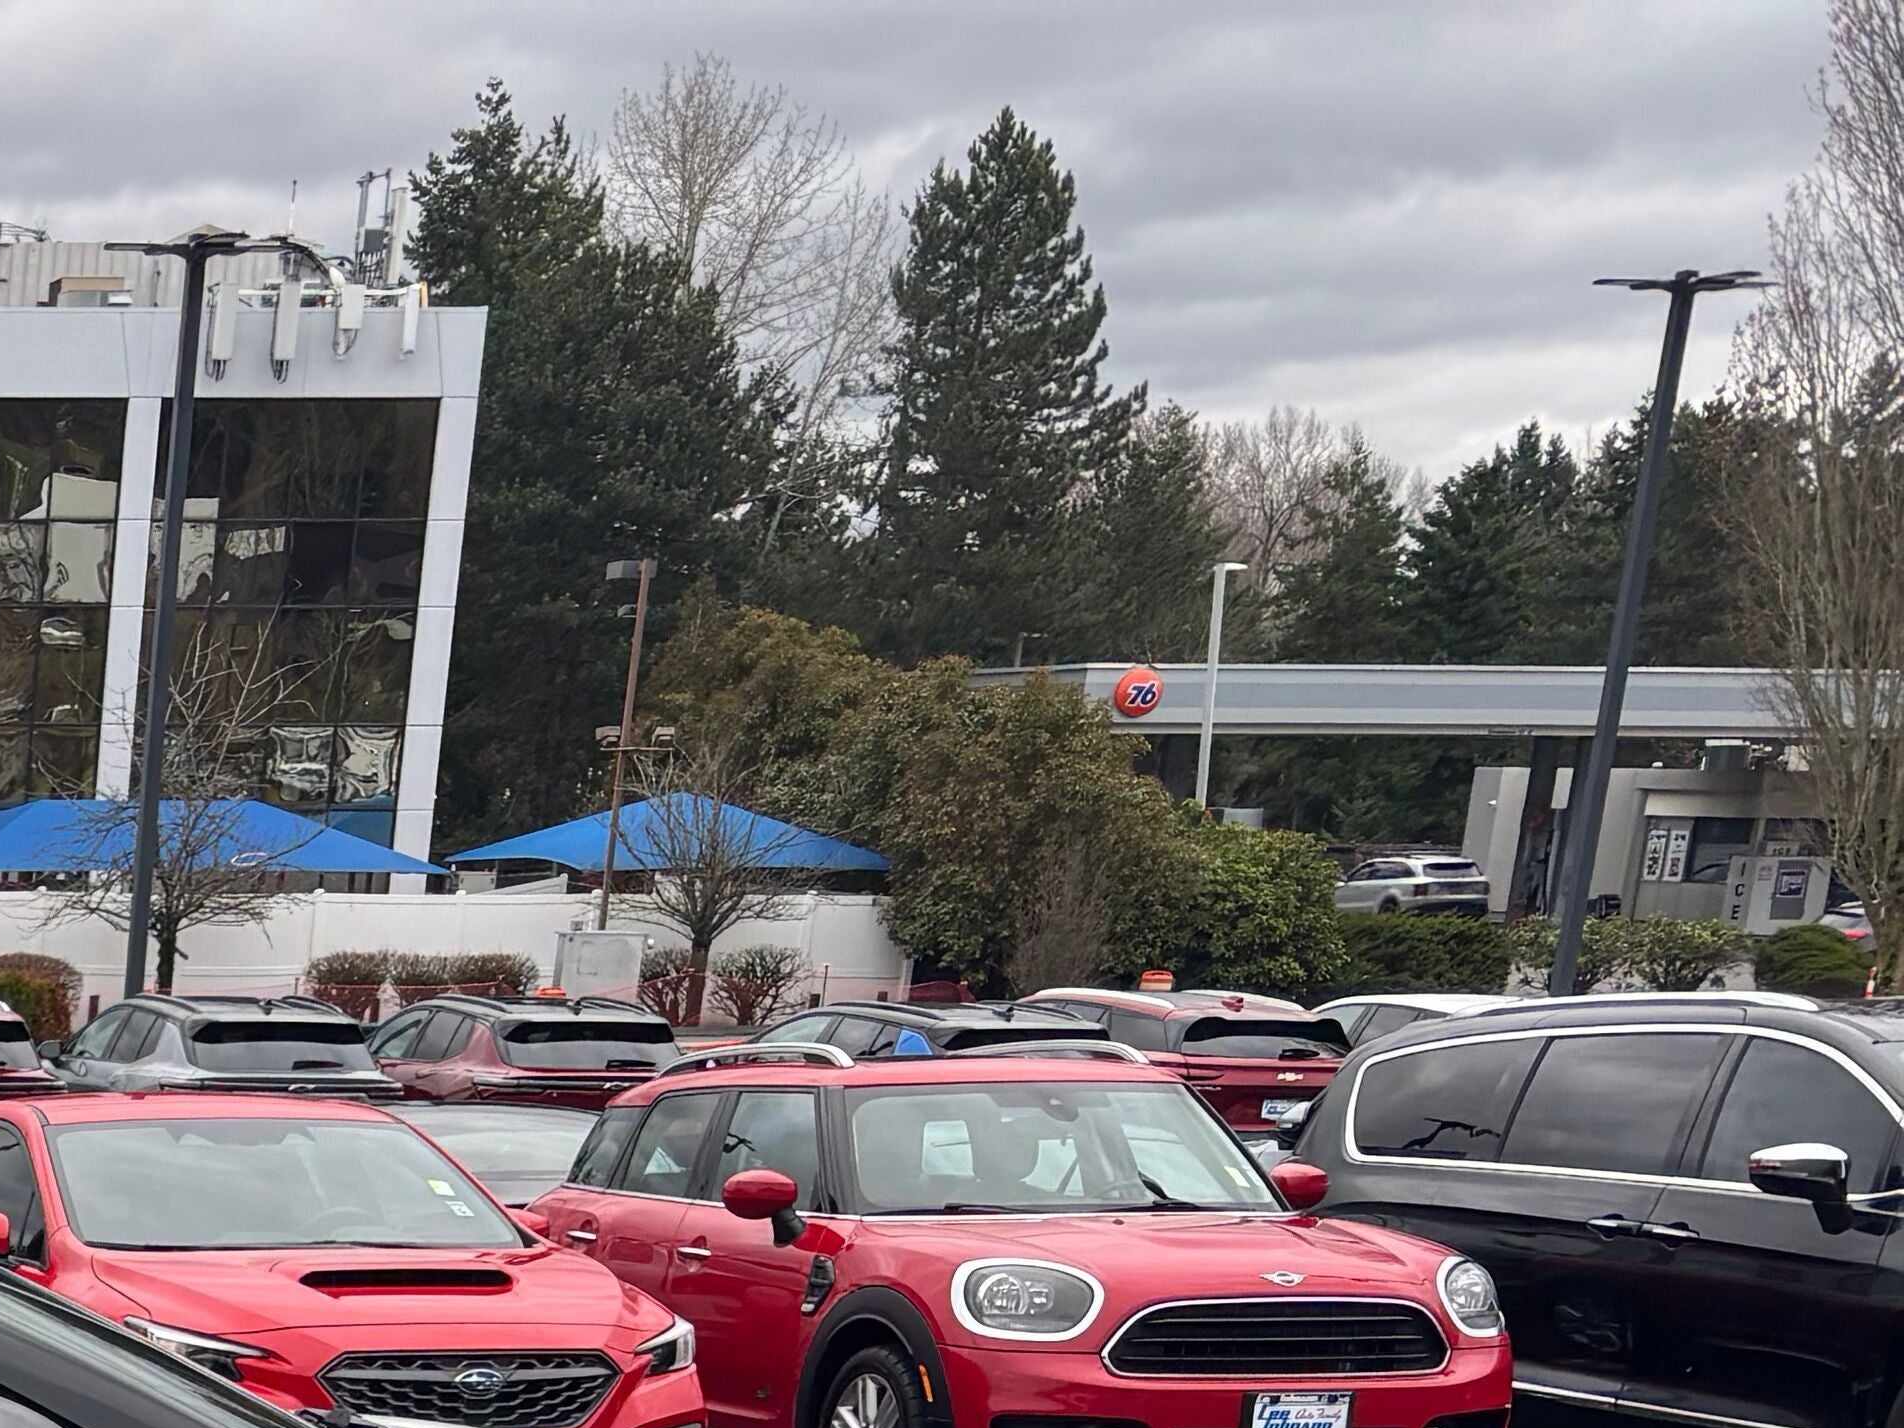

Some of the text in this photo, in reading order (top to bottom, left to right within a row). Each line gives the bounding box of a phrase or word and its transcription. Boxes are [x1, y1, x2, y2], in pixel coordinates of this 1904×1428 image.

[1125, 681, 1158, 707] 76
[1730, 862, 1748, 921] ICE
[1257, 1404, 1291, 1420] Lee
